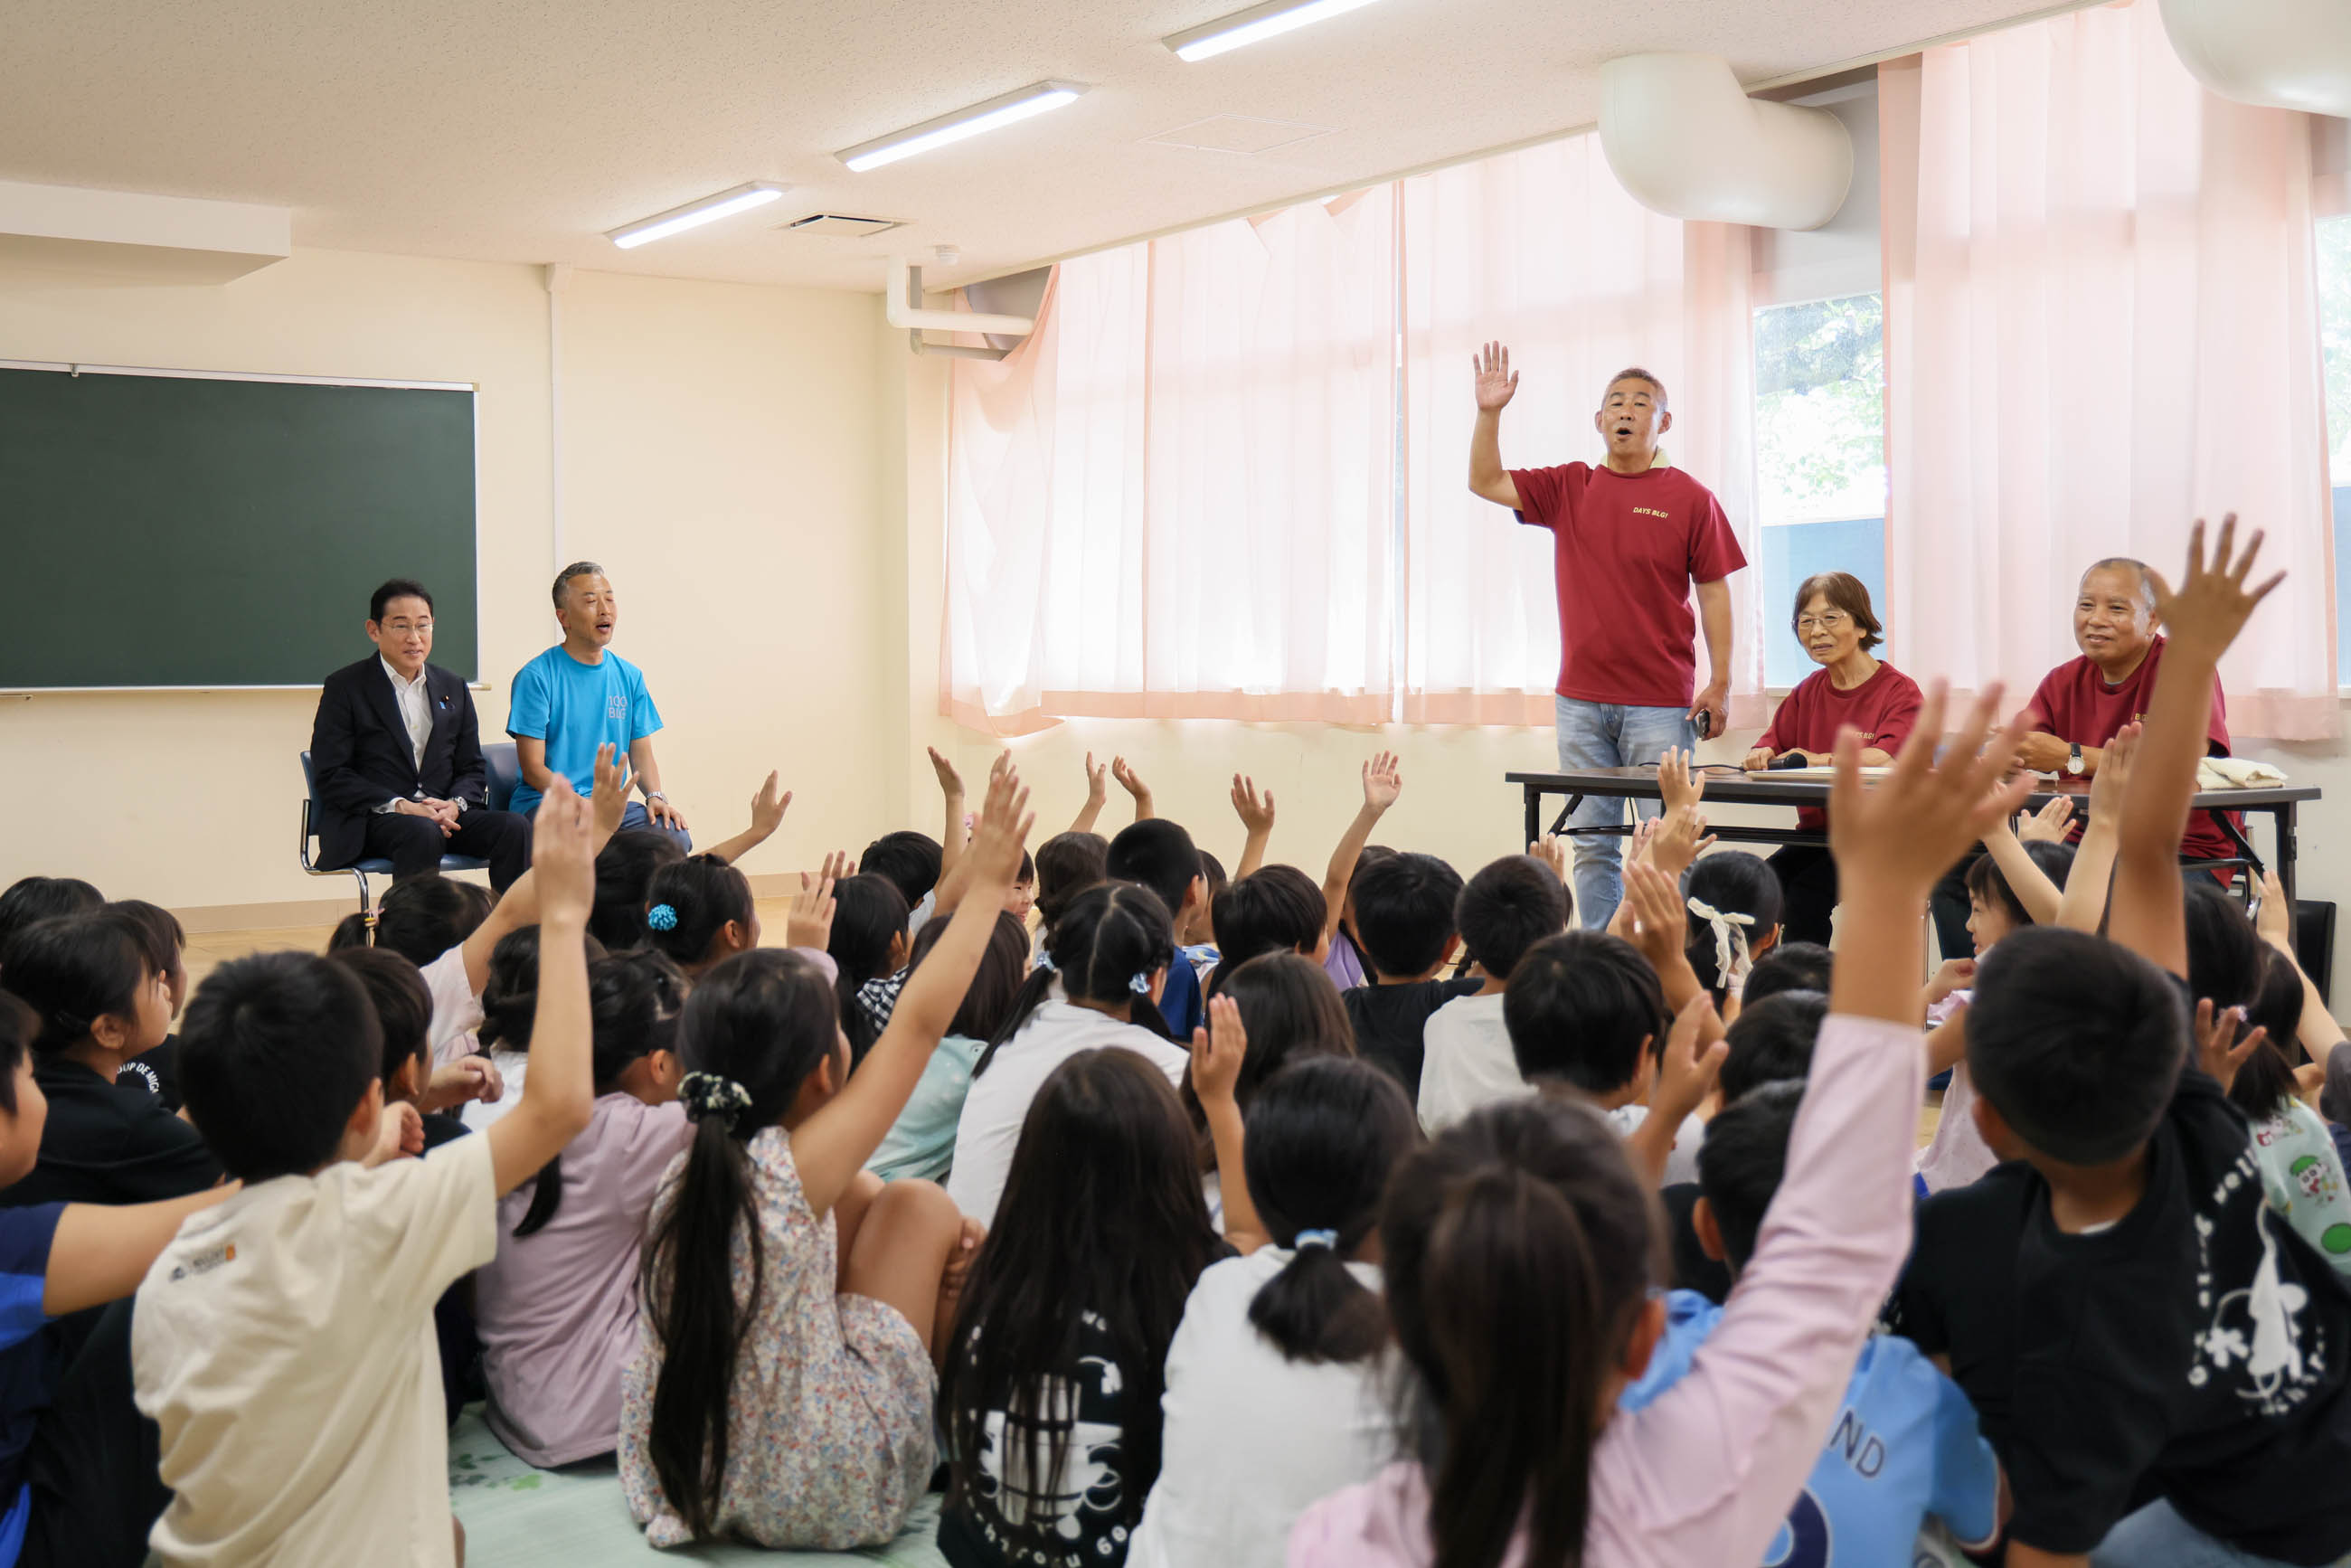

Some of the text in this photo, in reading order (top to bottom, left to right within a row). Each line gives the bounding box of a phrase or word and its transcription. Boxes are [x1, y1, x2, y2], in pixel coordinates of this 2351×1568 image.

[1633, 506, 1651, 515] DAYS
[609, 695, 628, 707] 100
[609, 707, 627, 719] BLG
